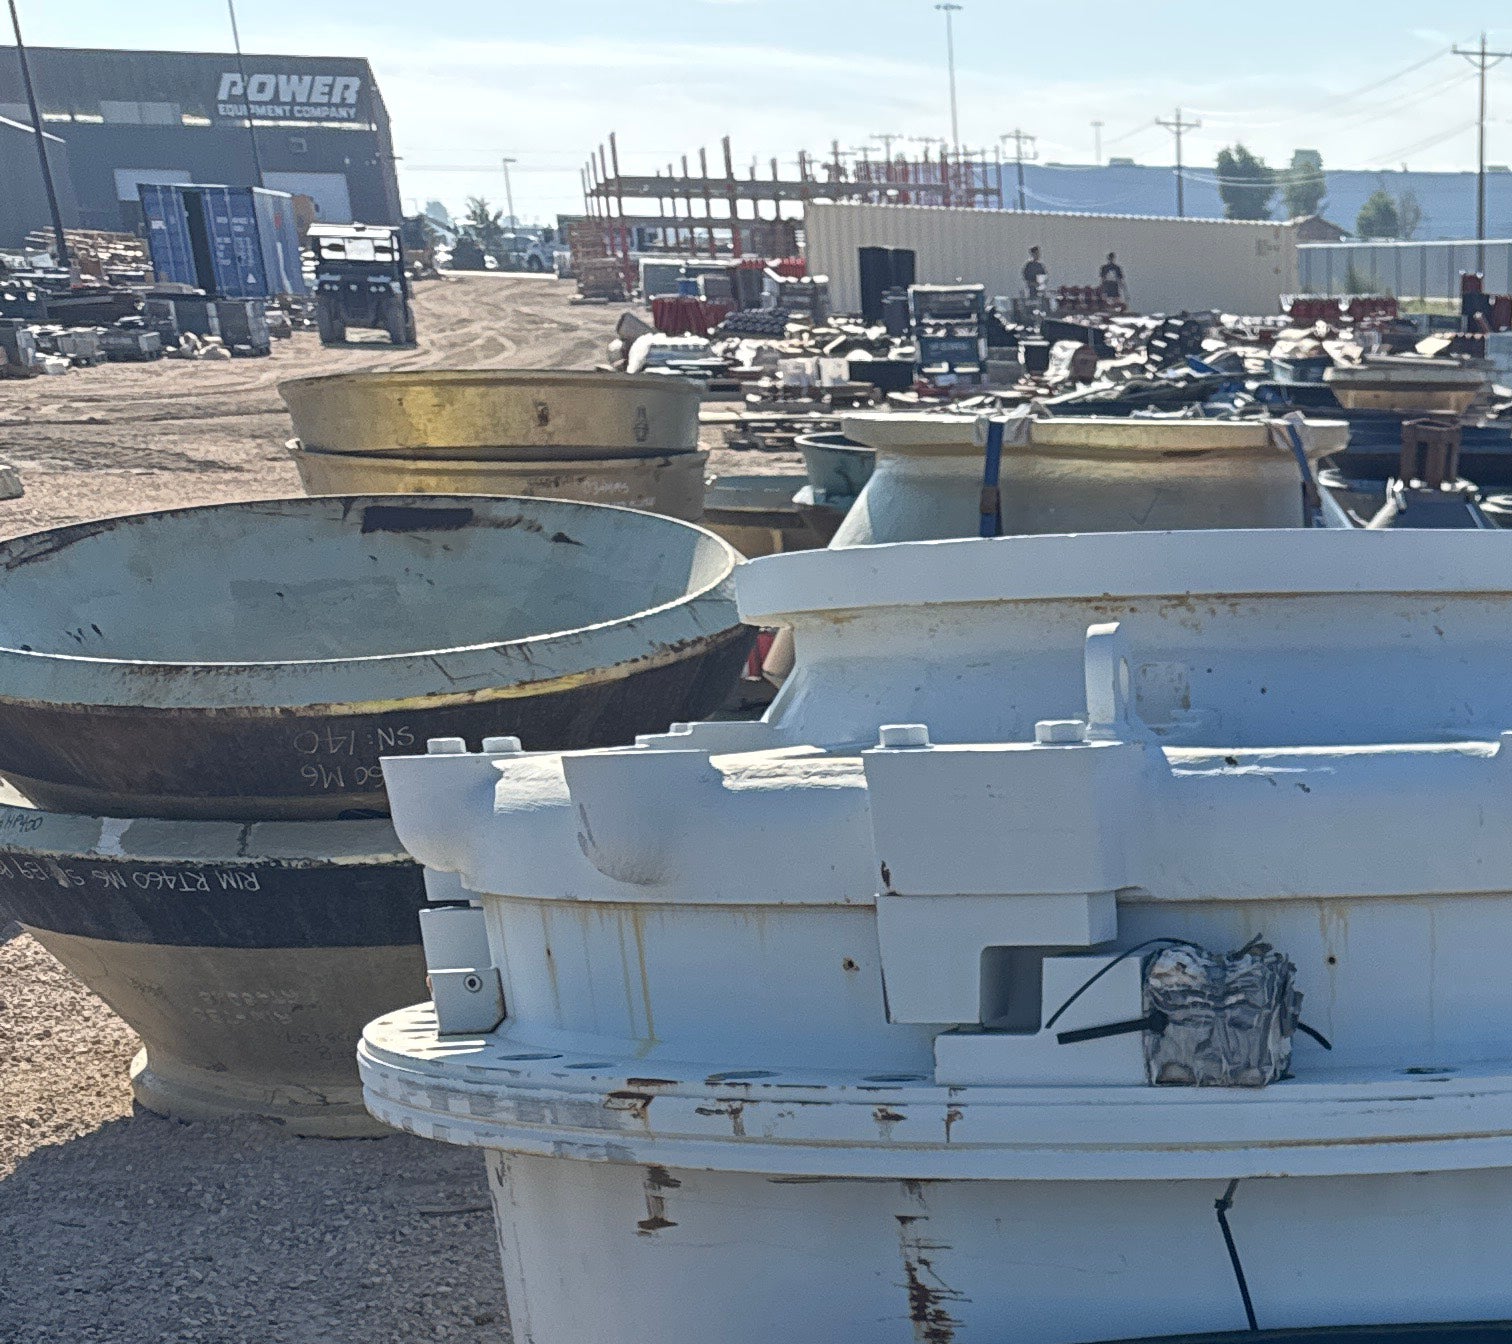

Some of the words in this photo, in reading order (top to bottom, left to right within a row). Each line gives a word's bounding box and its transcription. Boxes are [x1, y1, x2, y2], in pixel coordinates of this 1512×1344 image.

[217, 72, 361, 104] POWER
[217, 103, 291, 117] EQUIPMENT
[293, 106, 357, 119] COMPANY
[293, 725, 355, 756] 140
[132, 868, 211, 892] RT460
[214, 869, 261, 892] RIM
